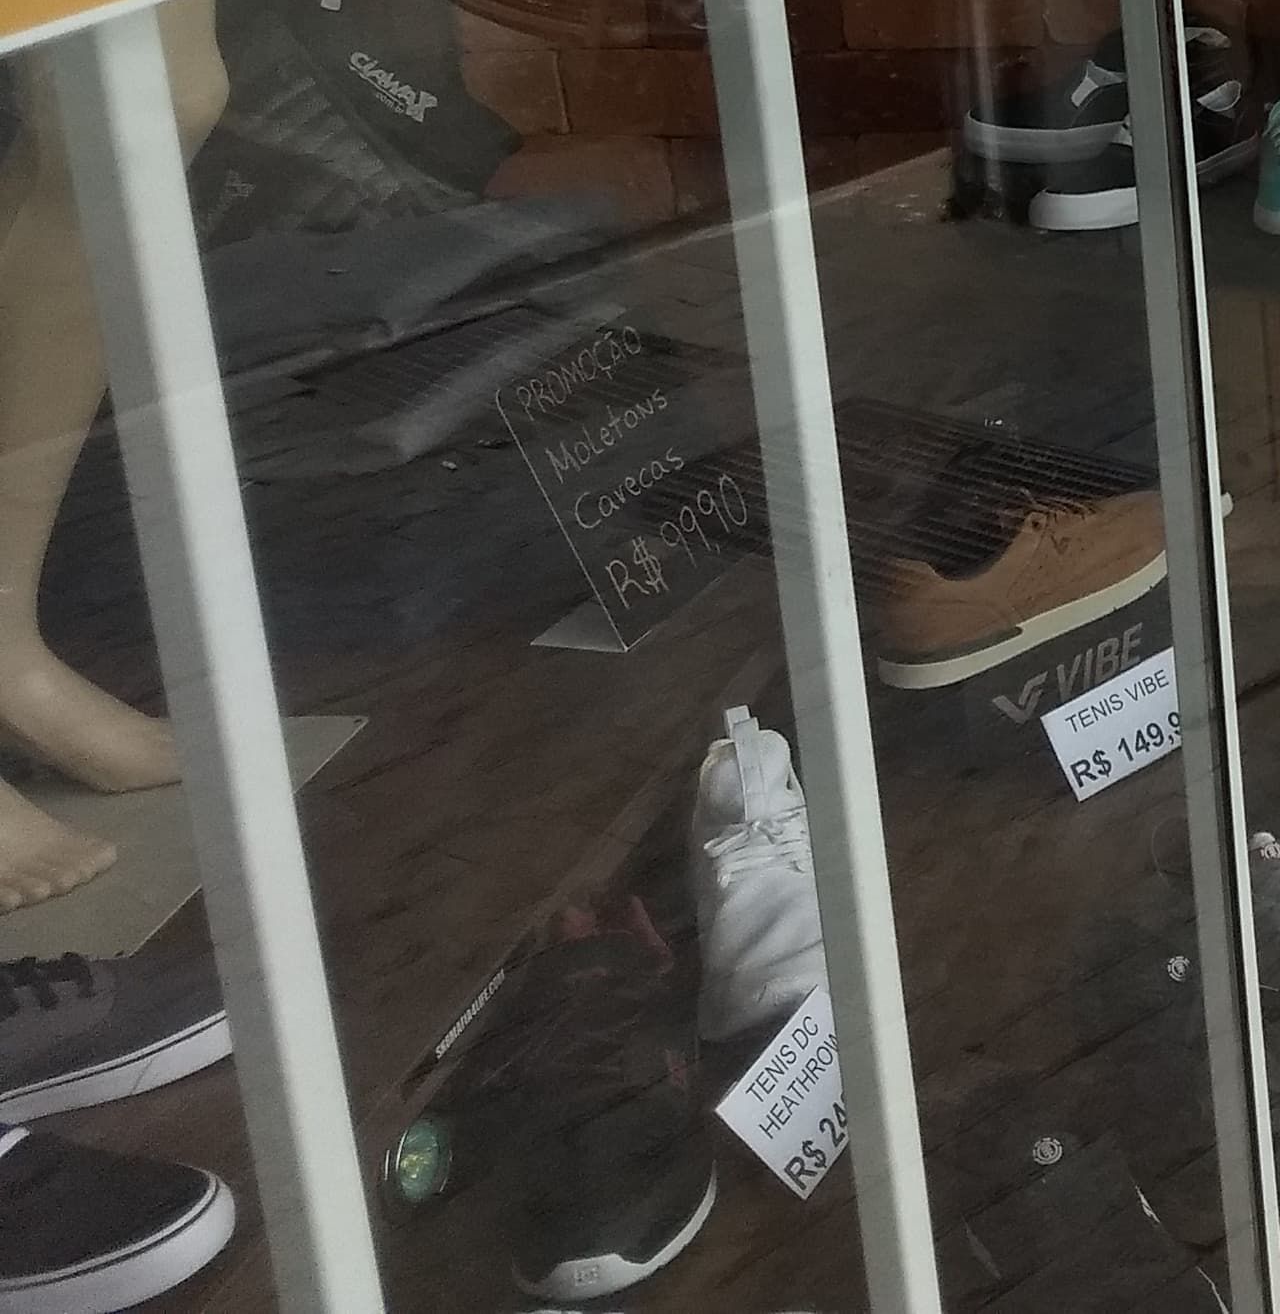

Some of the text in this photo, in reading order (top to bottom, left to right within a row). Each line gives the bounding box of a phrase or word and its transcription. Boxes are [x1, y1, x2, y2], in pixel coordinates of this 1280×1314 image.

[660, 474, 748, 569] 99,90
[1065, 669, 1169, 733] TENIS VIBE
[1070, 750, 1113, 788] R$
[745, 1015, 819, 1103] TENIS DC
[784, 1092, 849, 1190] R$ 24
